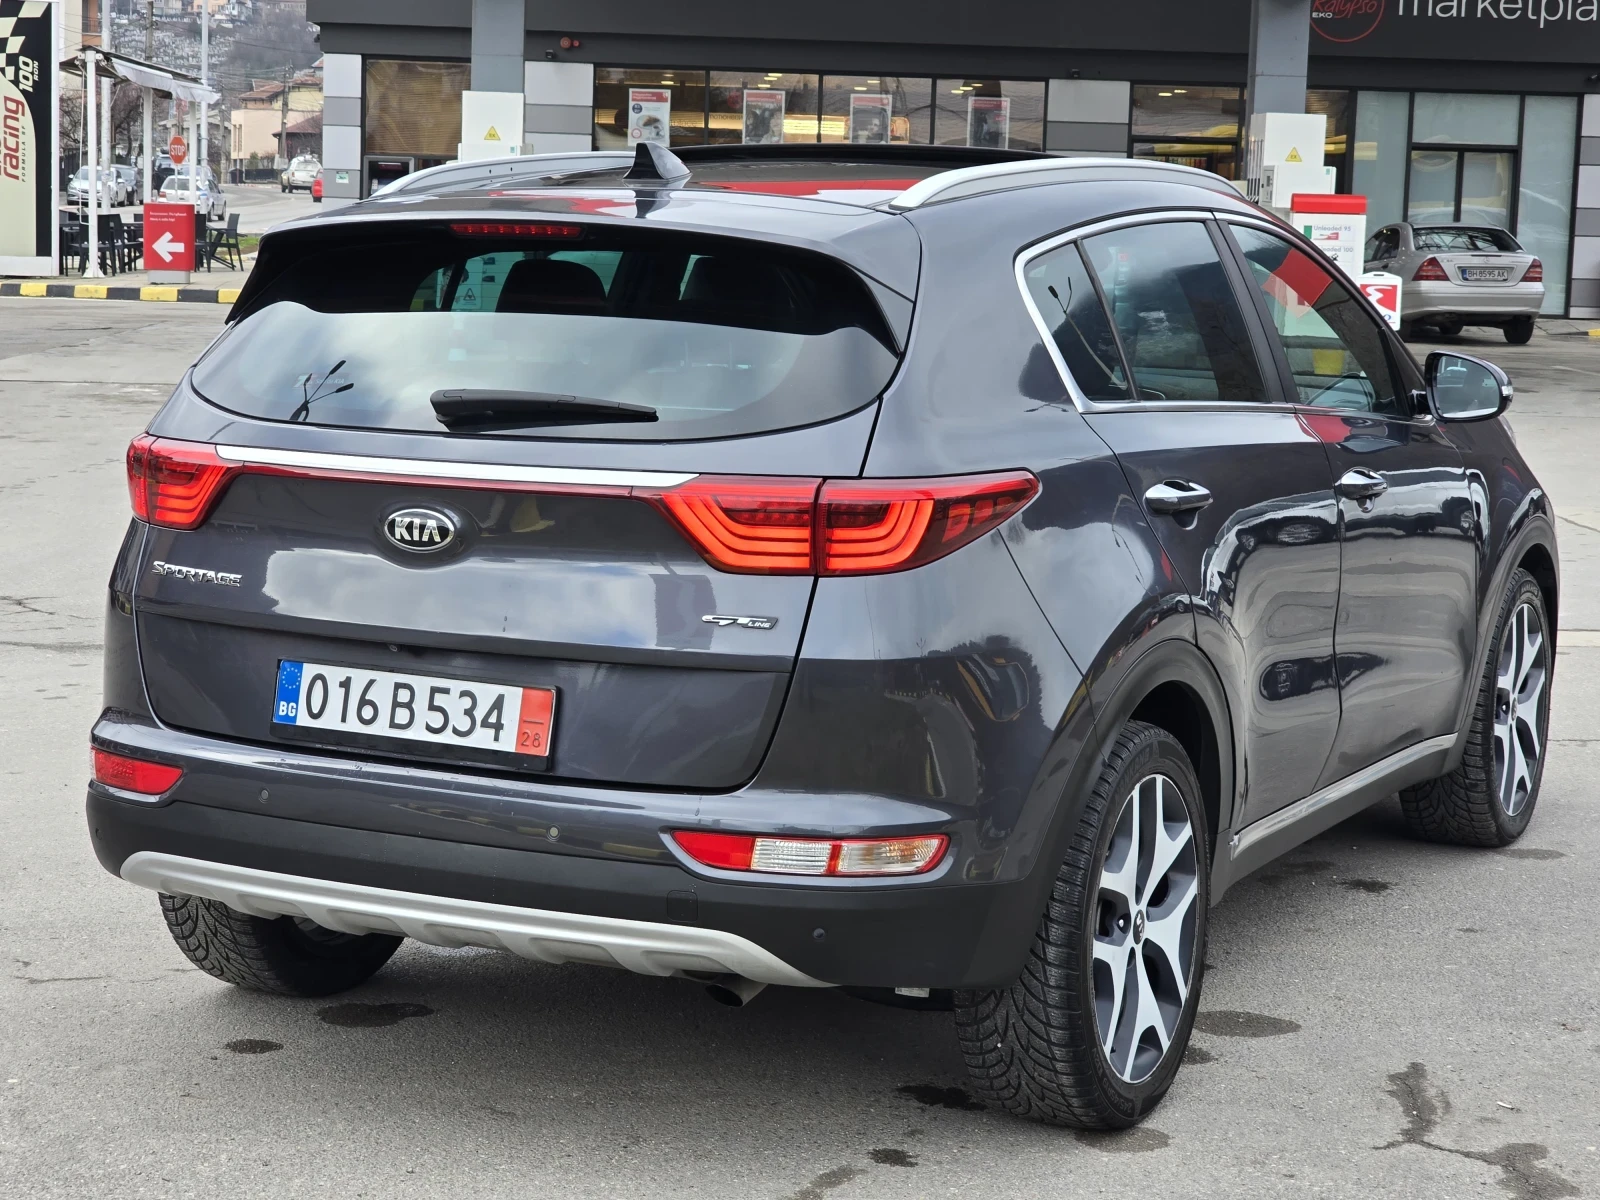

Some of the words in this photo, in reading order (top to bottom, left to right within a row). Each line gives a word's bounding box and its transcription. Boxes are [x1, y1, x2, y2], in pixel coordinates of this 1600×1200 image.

[19, 56, 33, 92] 100
[3, 95, 25, 180] racing
[171, 145, 185, 155] STOP
[394, 516, 442, 542] KIA
[150, 560, 243, 587] SPORTAGE
[747, 621, 772, 629] LINE
[278, 701, 297, 717] BG
[521, 731, 542, 749] 28
